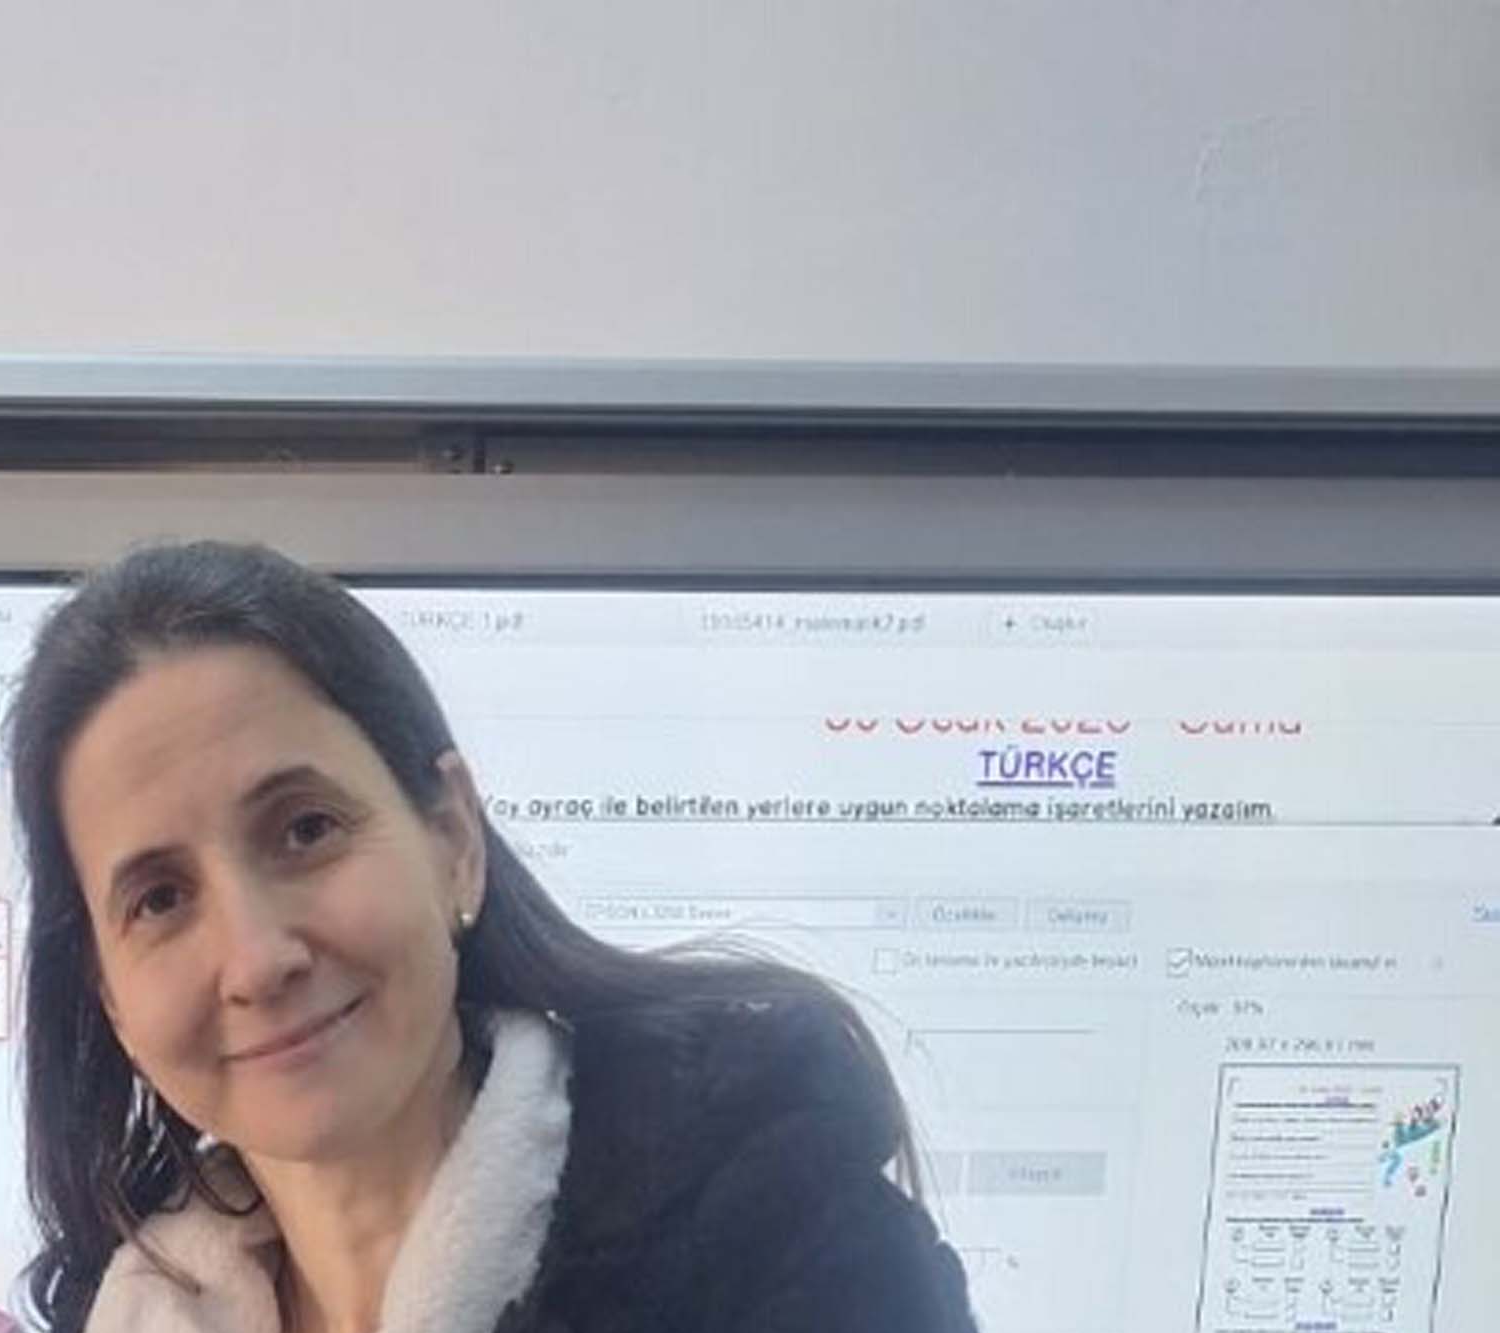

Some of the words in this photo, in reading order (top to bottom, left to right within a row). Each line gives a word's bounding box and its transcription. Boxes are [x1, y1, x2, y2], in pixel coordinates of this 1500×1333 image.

[978, 746, 1117, 788] TÜRKÇE
[636, 795, 739, 817] belirtilen
[838, 798, 908, 821] uygun
[913, 797, 1041, 818] noktalama
